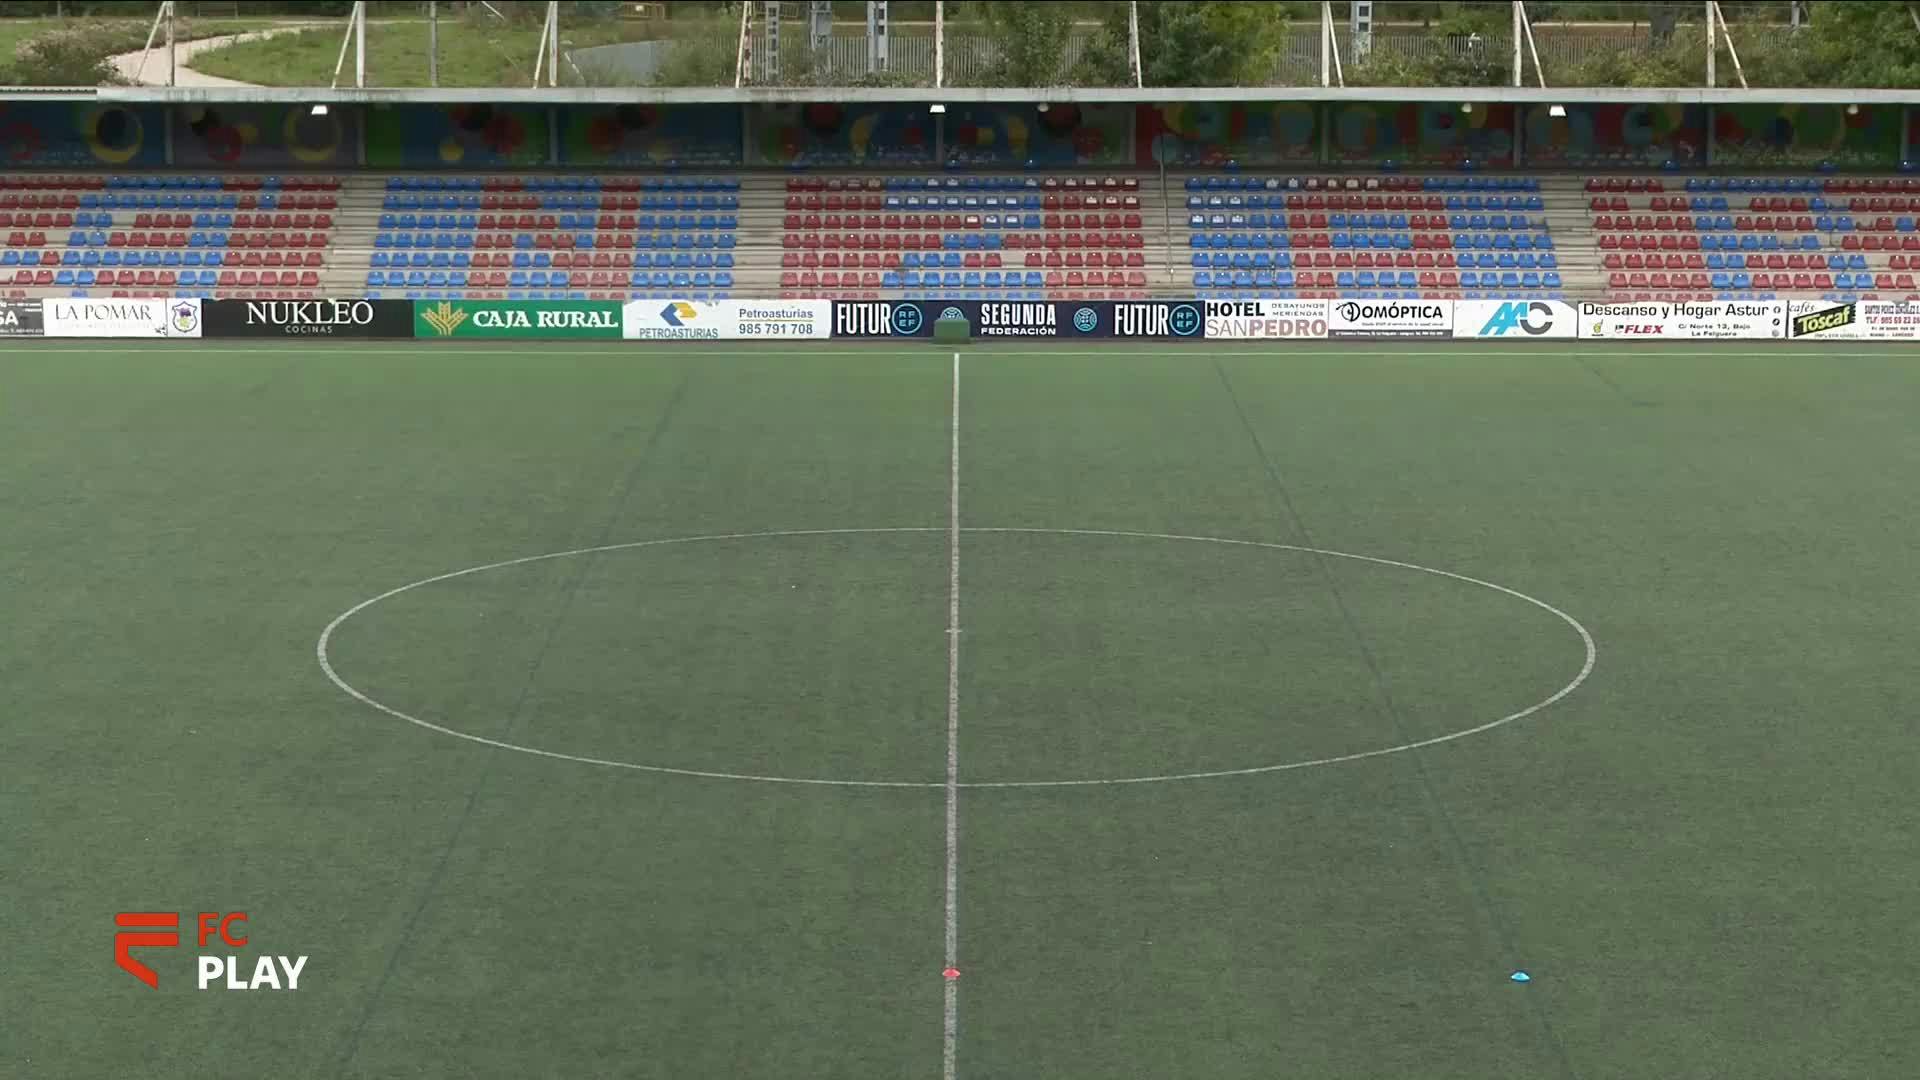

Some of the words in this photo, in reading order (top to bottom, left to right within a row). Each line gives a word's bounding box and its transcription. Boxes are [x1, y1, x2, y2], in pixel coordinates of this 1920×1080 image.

[55, 304, 79, 320] LA
[85, 304, 152, 320] POMAR
[246, 301, 374, 324] NUKLEO
[739, 309, 814, 319] Petroasturias
[981, 304, 1056, 326] SEGUNDA
[1207, 302, 1265, 317] HOTEL
[1583, 303, 1657, 316] Descanso
[1662, 306, 1669, 319] y
[1674, 303, 1721, 319] Hogar
[1725, 303, 1769, 316] Astur
[473, 310, 532, 328] CAJA
[537, 311, 619, 328] RURAL
[1798, 304, 1851, 333] Toscaf
[285, 325, 333, 334] COCINAS
[639, 328, 718, 339] PETROASTURIAS
[739, 324, 761, 335] 985
[766, 324, 786, 335] 791
[791, 324, 813, 335] 708
[981, 326, 1056, 336] FEDERACIÓN
[1624, 325, 1664, 334] FLEX
